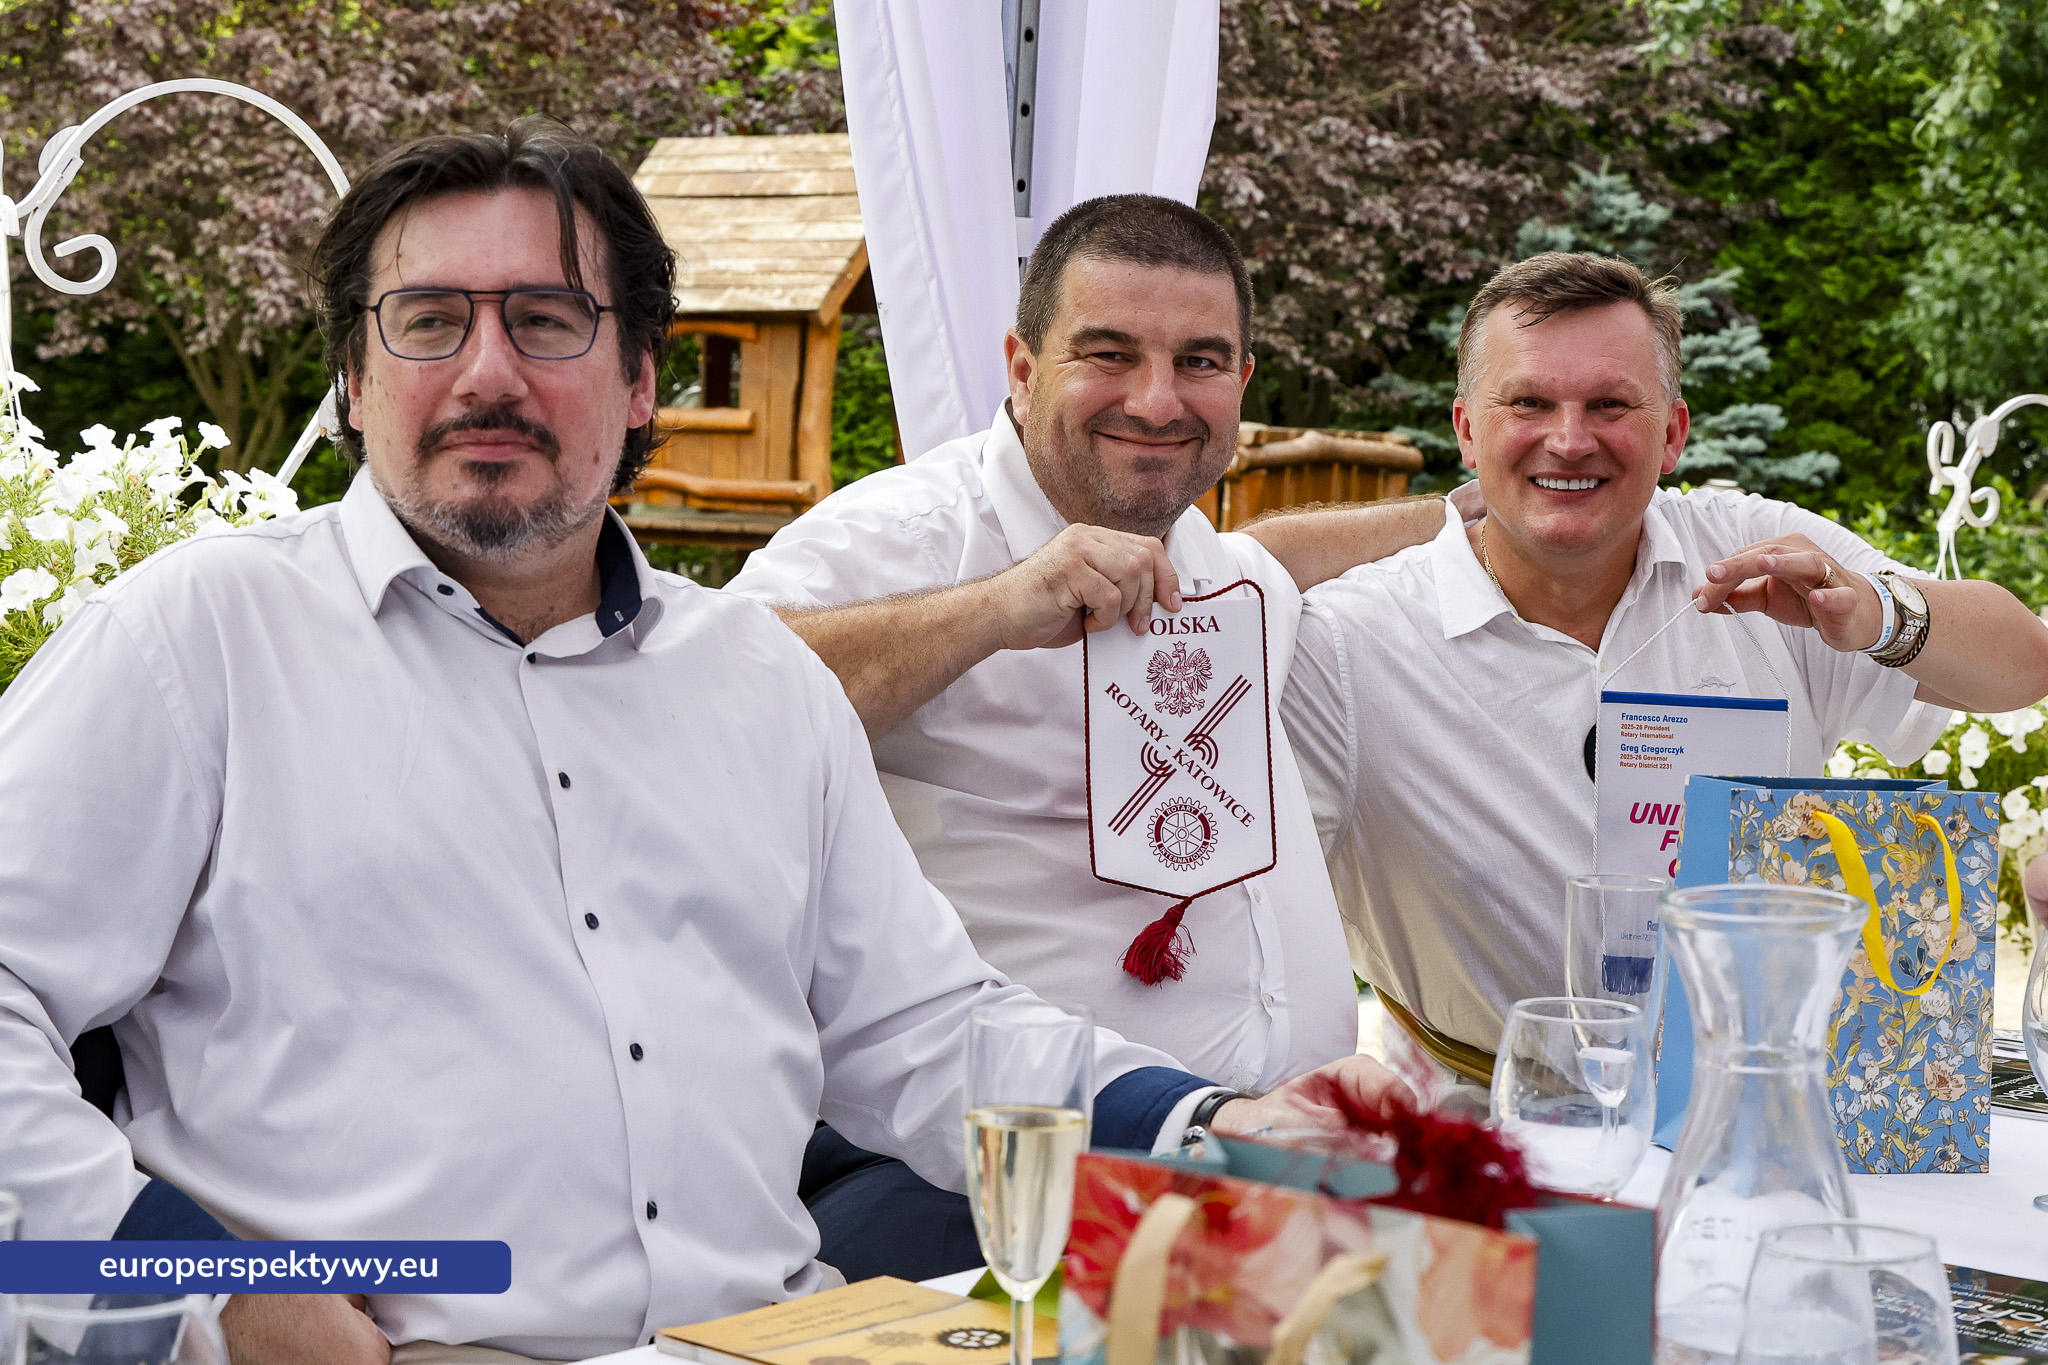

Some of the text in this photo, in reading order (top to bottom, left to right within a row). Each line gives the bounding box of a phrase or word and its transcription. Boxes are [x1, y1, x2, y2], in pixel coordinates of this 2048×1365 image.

[1150, 615, 1220, 636] OLSKA
[1621, 712, 1688, 724] Francesco Arezzo
[1644, 724, 1670, 732] President
[1640, 732, 1674, 740] International
[1104, 682, 1169, 744] ROTARY
[1172, 747, 1256, 828] KATOWICE
[1620, 744, 1684, 756] Greg Gregorczyk
[1643, 754, 1668, 762] Governor
[1638, 762, 1658, 770] District
[1166, 806, 1196, 814] ROTARY
[1630, 802, 1680, 826] UNI
[1660, 830, 1680, 851] F
[1160, 844, 1209, 864] INTERNATIONAL
